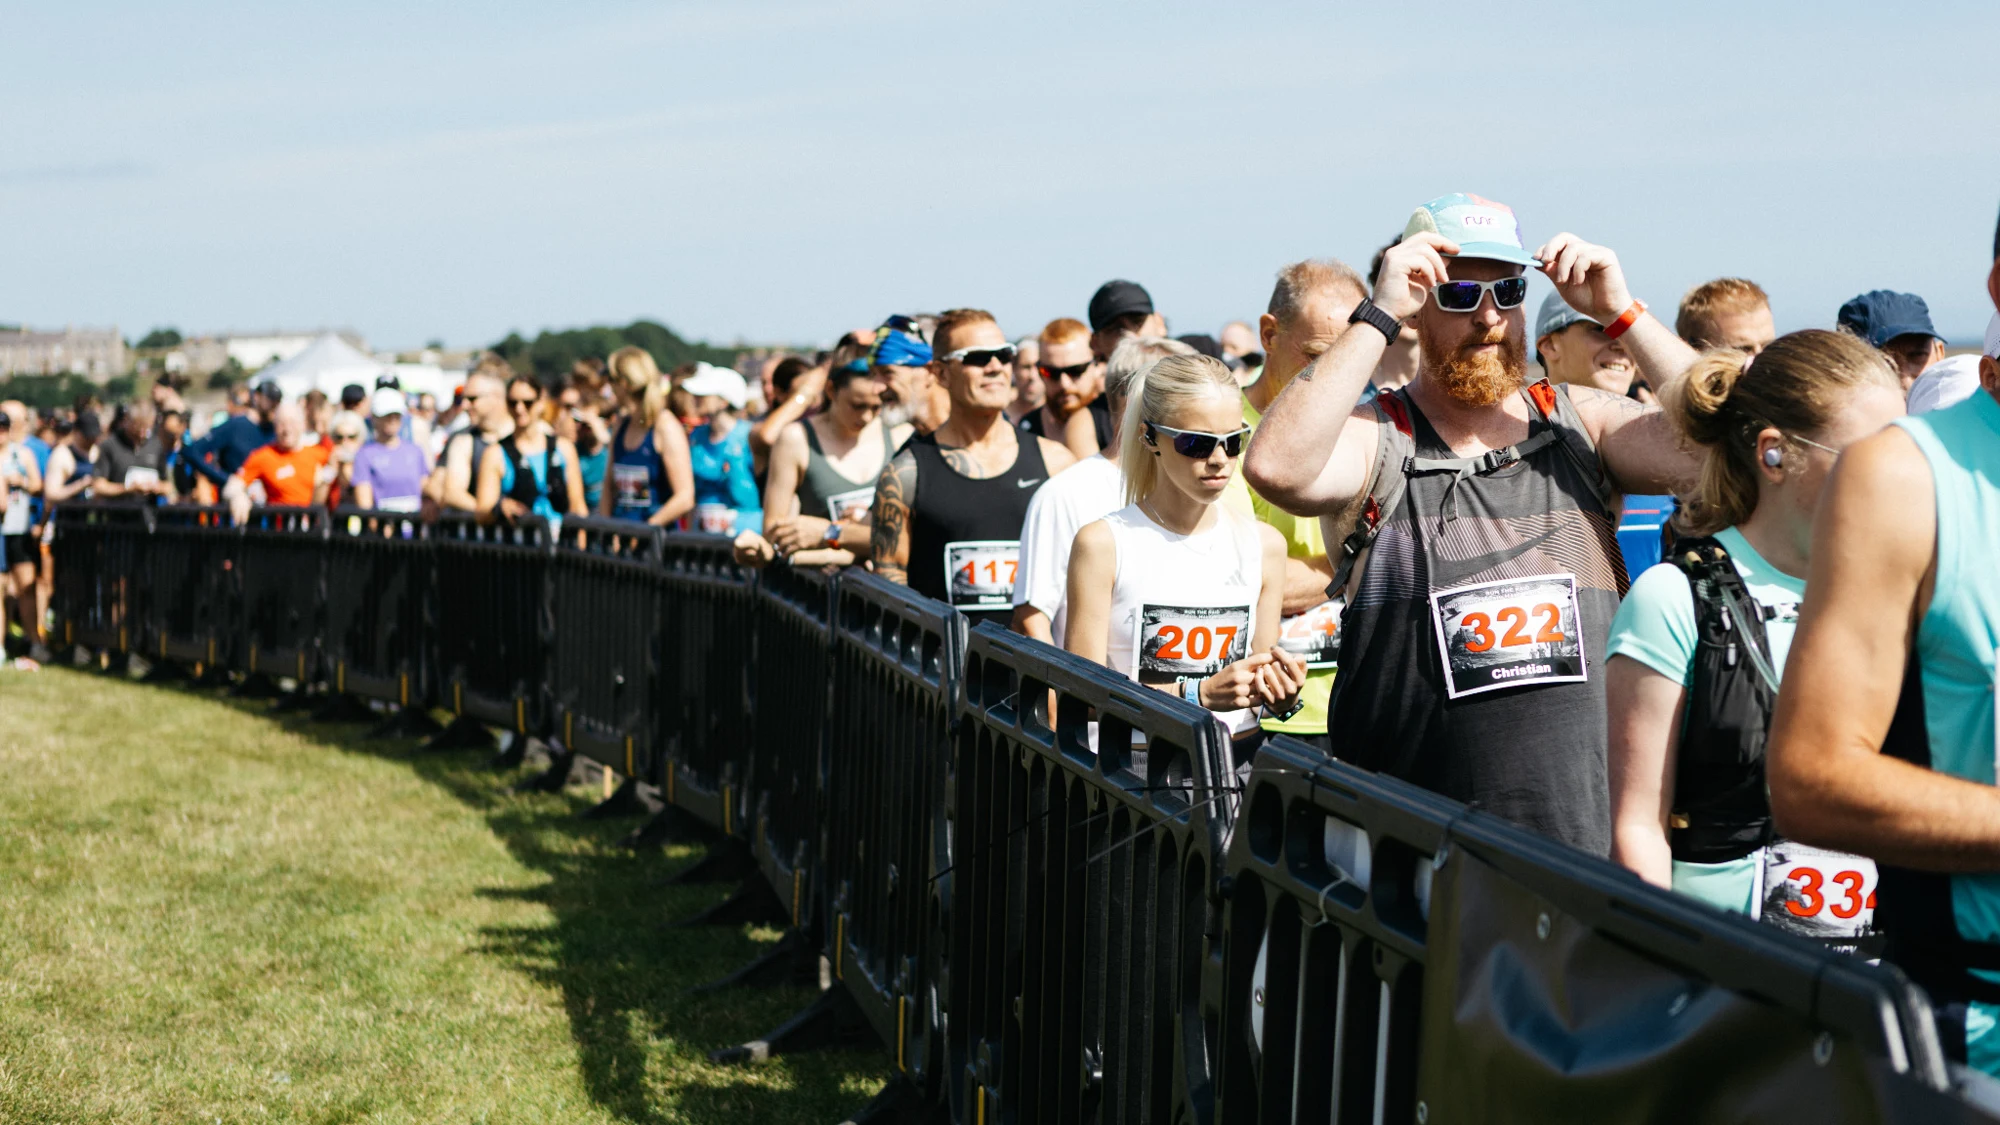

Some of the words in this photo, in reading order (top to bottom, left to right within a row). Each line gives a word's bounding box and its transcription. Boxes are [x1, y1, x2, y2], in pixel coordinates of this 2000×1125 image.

[962, 560, 1019, 585] 117
[1278, 606, 1337, 639] 24
[1461, 602, 1565, 653] 322
[1155, 625, 1238, 660] 207
[1491, 663, 1552, 680] Christian
